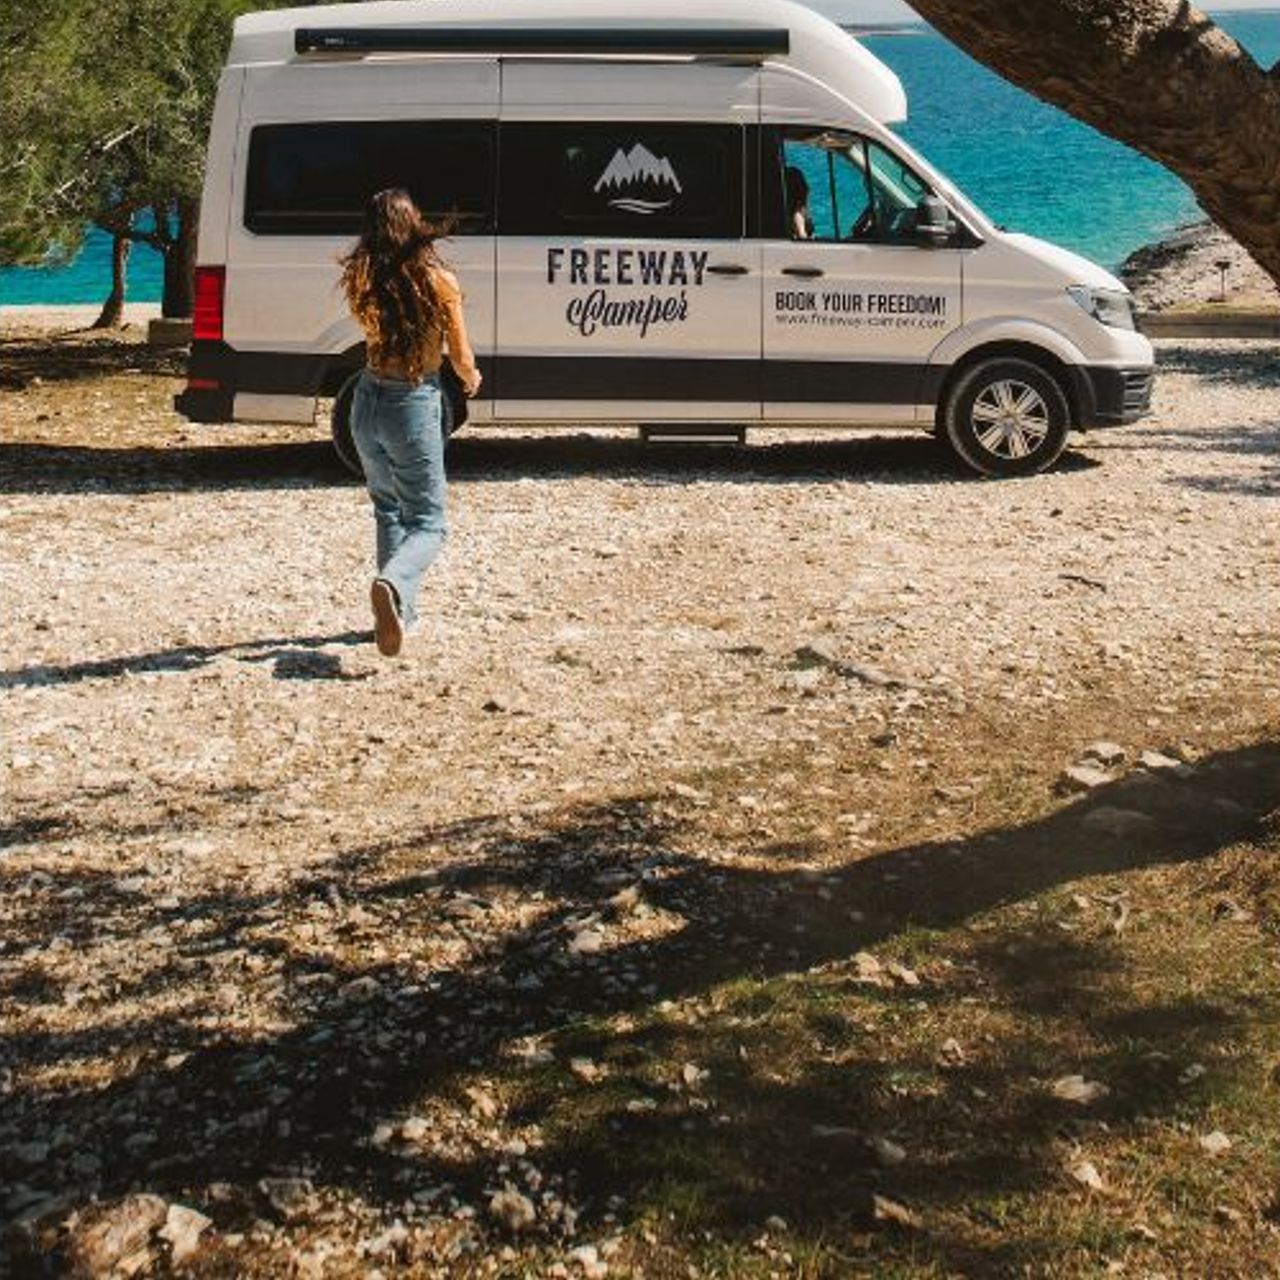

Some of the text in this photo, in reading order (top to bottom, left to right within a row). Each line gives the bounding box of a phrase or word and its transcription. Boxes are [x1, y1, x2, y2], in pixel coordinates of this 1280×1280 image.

[547, 247, 708, 286] FREEWAY
[566, 289, 688, 339] Camper
[775, 291, 946, 316] BOOK YOUR FREEDOM!
